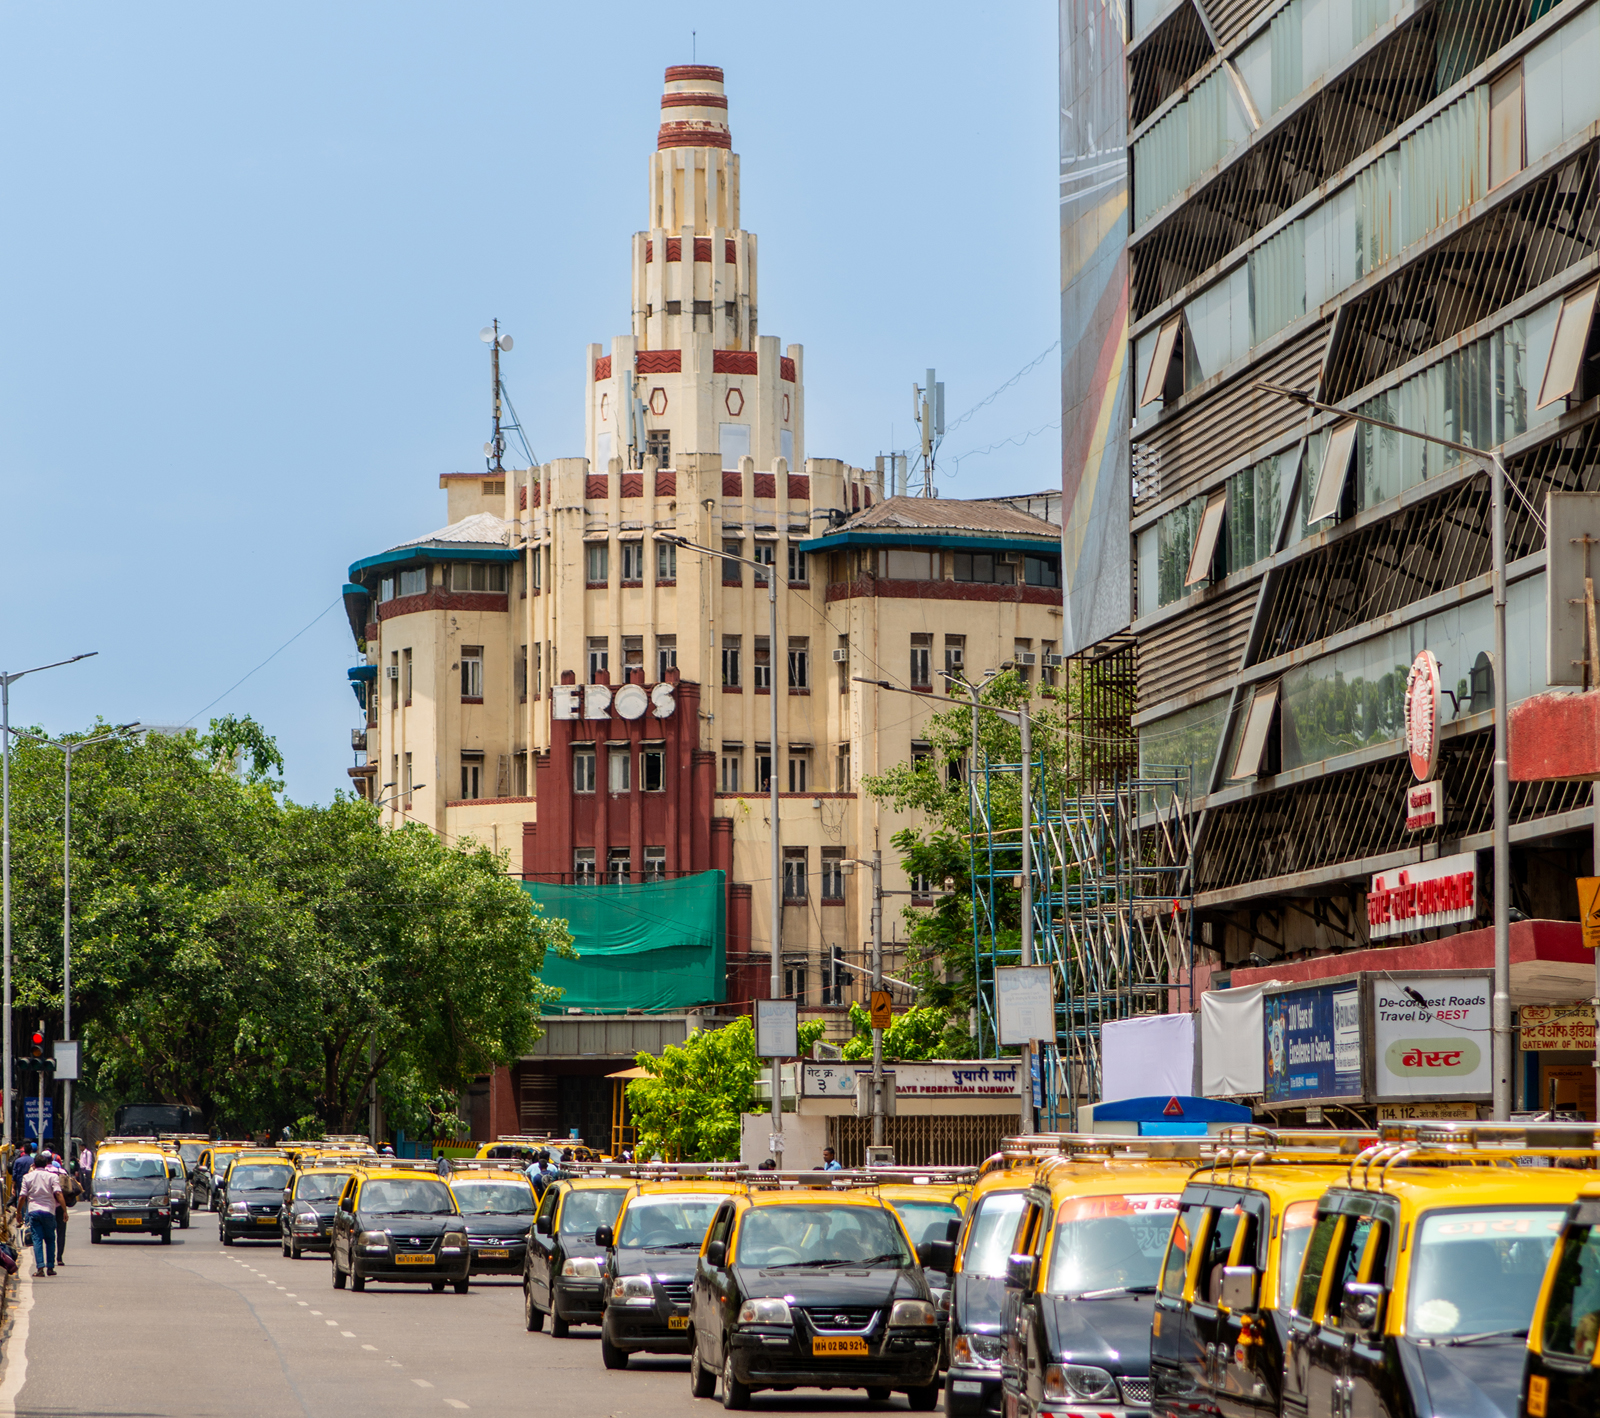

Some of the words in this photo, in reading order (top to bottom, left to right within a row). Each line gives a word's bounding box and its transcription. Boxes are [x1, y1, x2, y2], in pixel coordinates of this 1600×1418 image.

[552, 682, 676, 721] EROS
[1449, 996, 1486, 1007] Roads
[1380, 1011, 1415, 1021] Travel
[1418, 1011, 1432, 1022] by
[1436, 1010, 1469, 1020] BEST
[1522, 1041, 1558, 1049] GATEWAY
[1562, 1041, 1571, 1049] OF
[1575, 1040, 1597, 1049] INDIA
[1402, 1048, 1464, 1067] बेस्ट
[807, 1067, 820, 1077] गेट
[952, 1066, 989, 1085] भुयारी
[993, 1066, 1016, 1082] मार्ग
[818, 1079, 827, 1092] ३
[670, 1319, 681, 1328] MH
[815, 1342, 826, 1351] MH
[828, 1341, 837, 1351] 02
[839, 1341, 849, 1351] BQ
[849, 1341, 867, 1351] 9214
